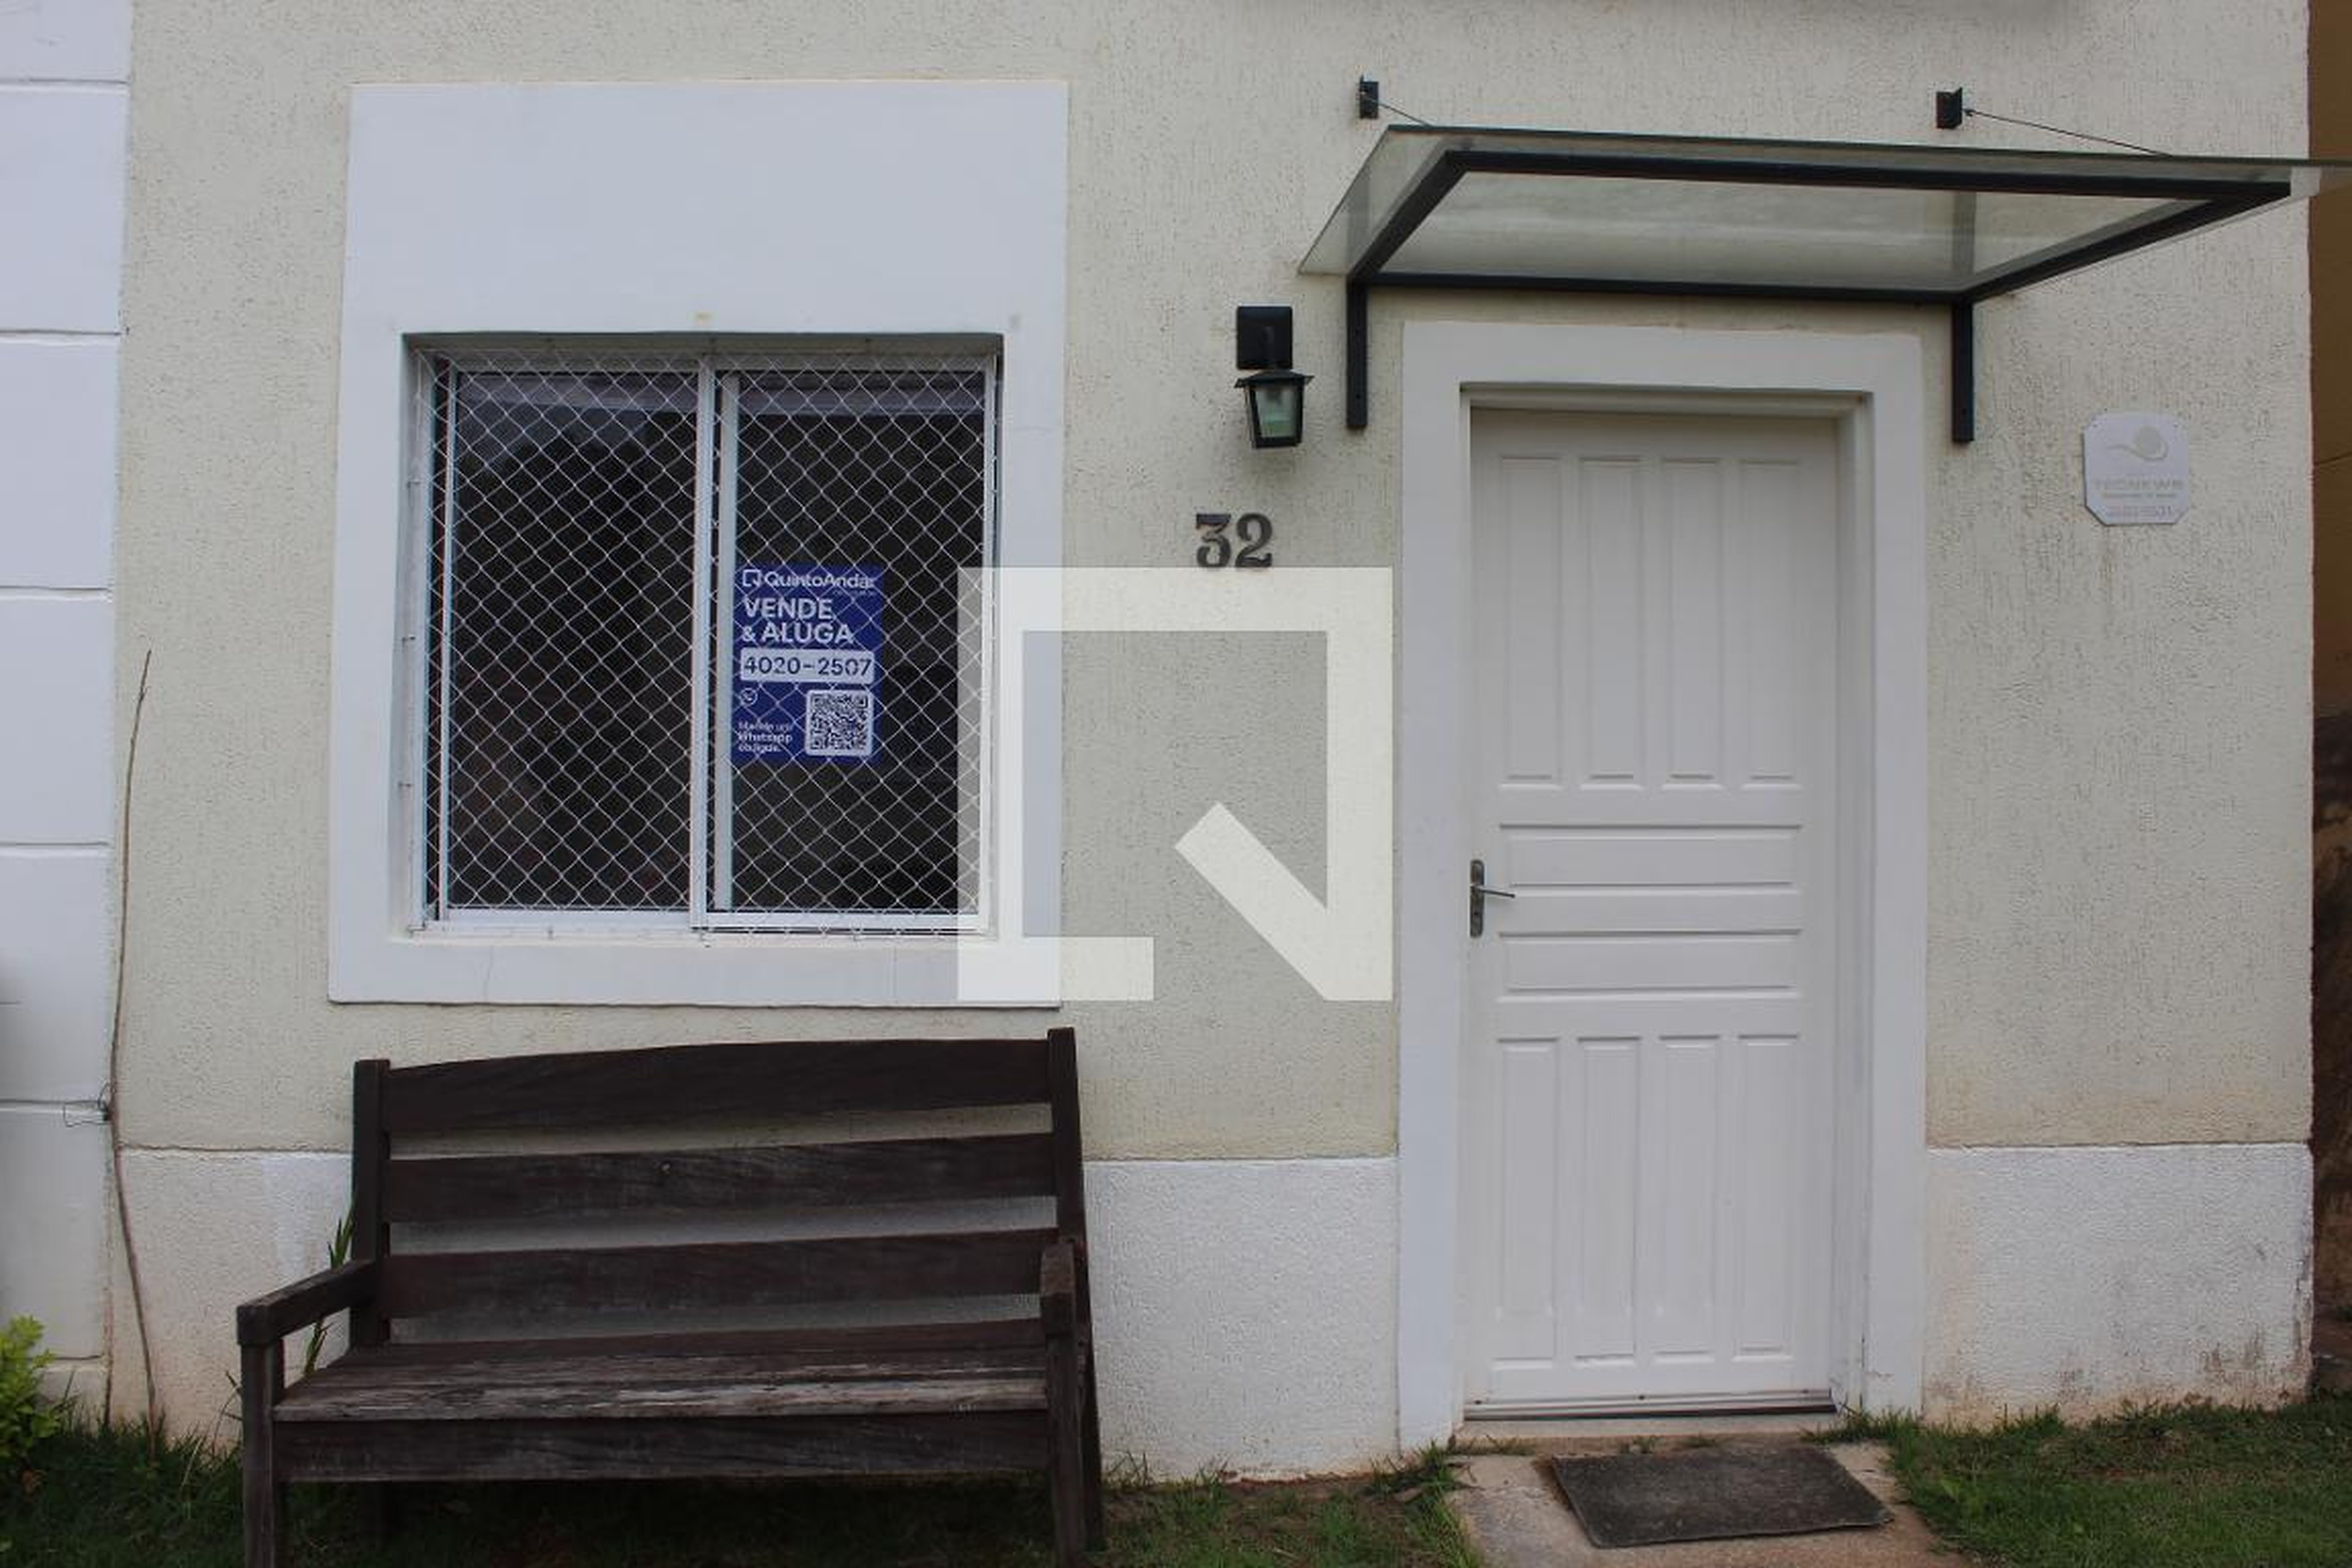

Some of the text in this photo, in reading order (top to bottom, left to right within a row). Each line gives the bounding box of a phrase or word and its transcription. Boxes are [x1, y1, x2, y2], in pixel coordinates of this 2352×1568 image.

[1196, 513, 1272, 567] 32
[744, 597, 833, 619] VENDE
[741, 622, 855, 643] & ALUGA
